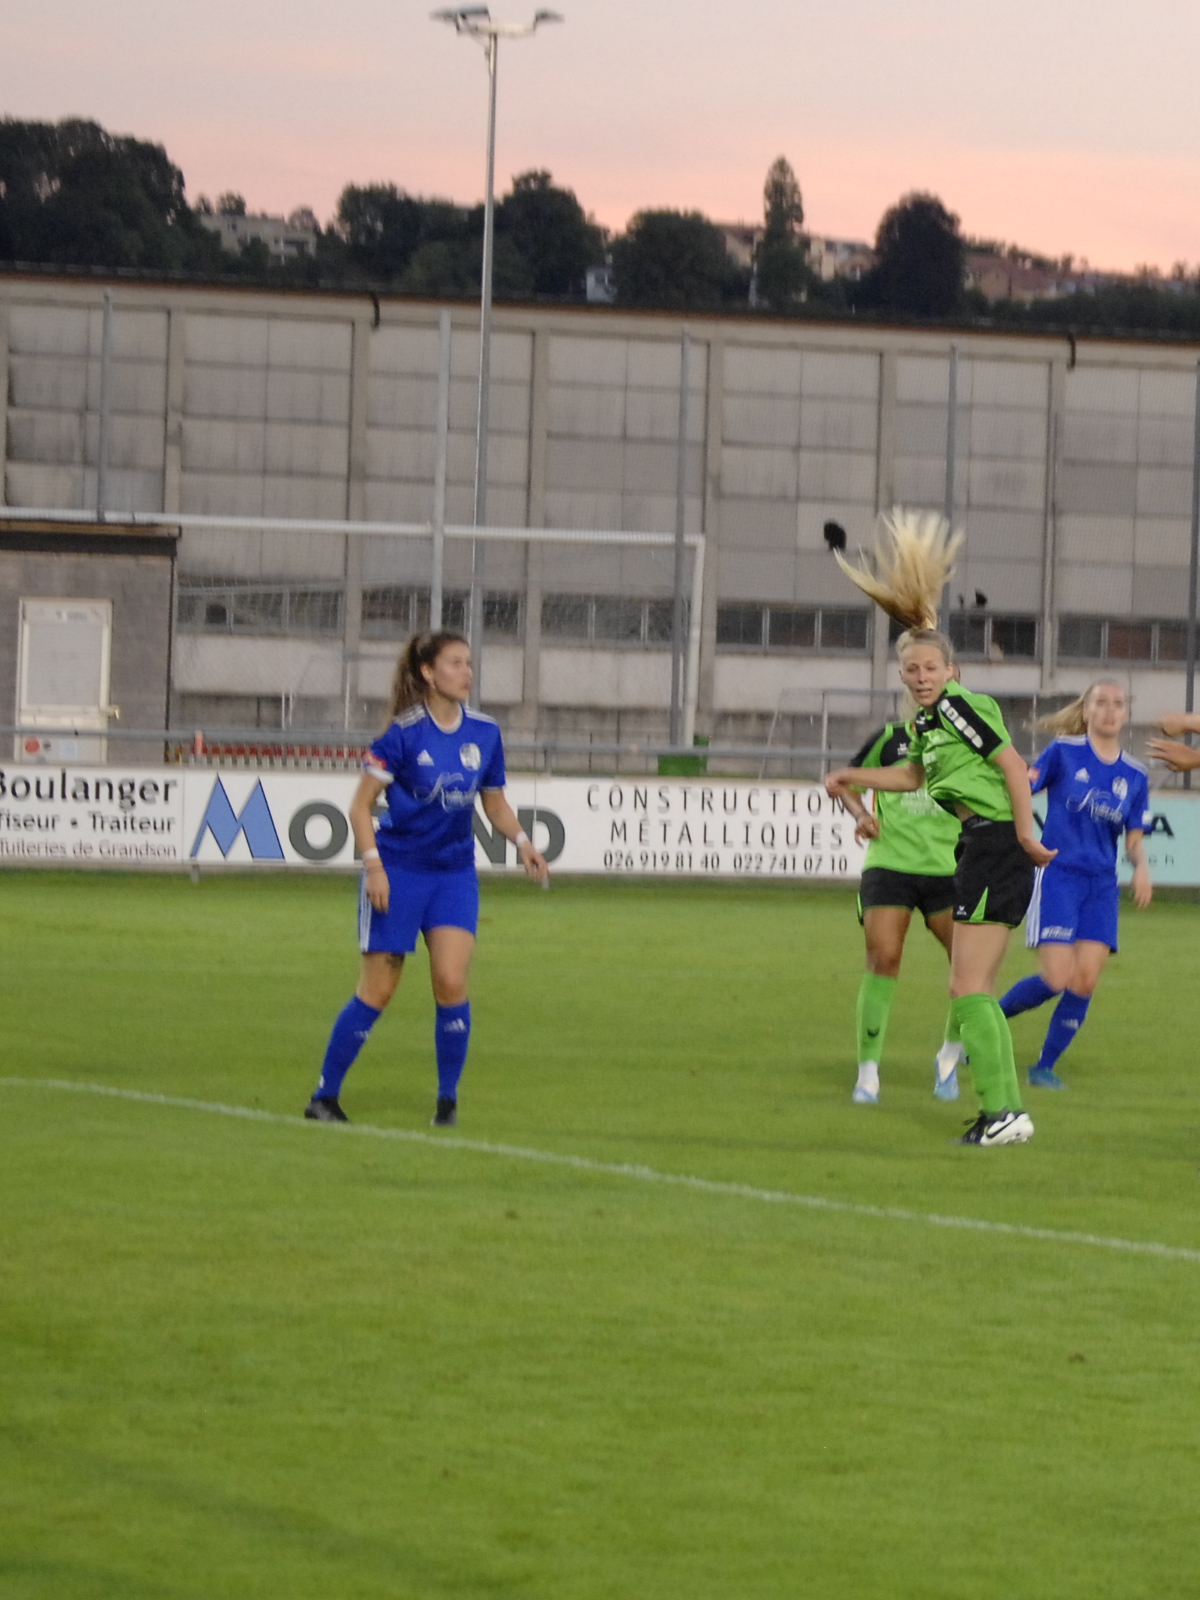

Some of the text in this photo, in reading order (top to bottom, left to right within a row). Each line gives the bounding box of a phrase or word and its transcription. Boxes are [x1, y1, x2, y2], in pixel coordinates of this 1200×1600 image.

[87, 810, 175, 833] Traiteur
[190, 773, 566, 863] MOND
[610, 813, 843, 850] MÉTALLIQUES
[73, 839, 94, 858] de
[100, 839, 177, 858] Grandson
[603, 851, 848, 873] 026 919 81 40 022 741 07 10
